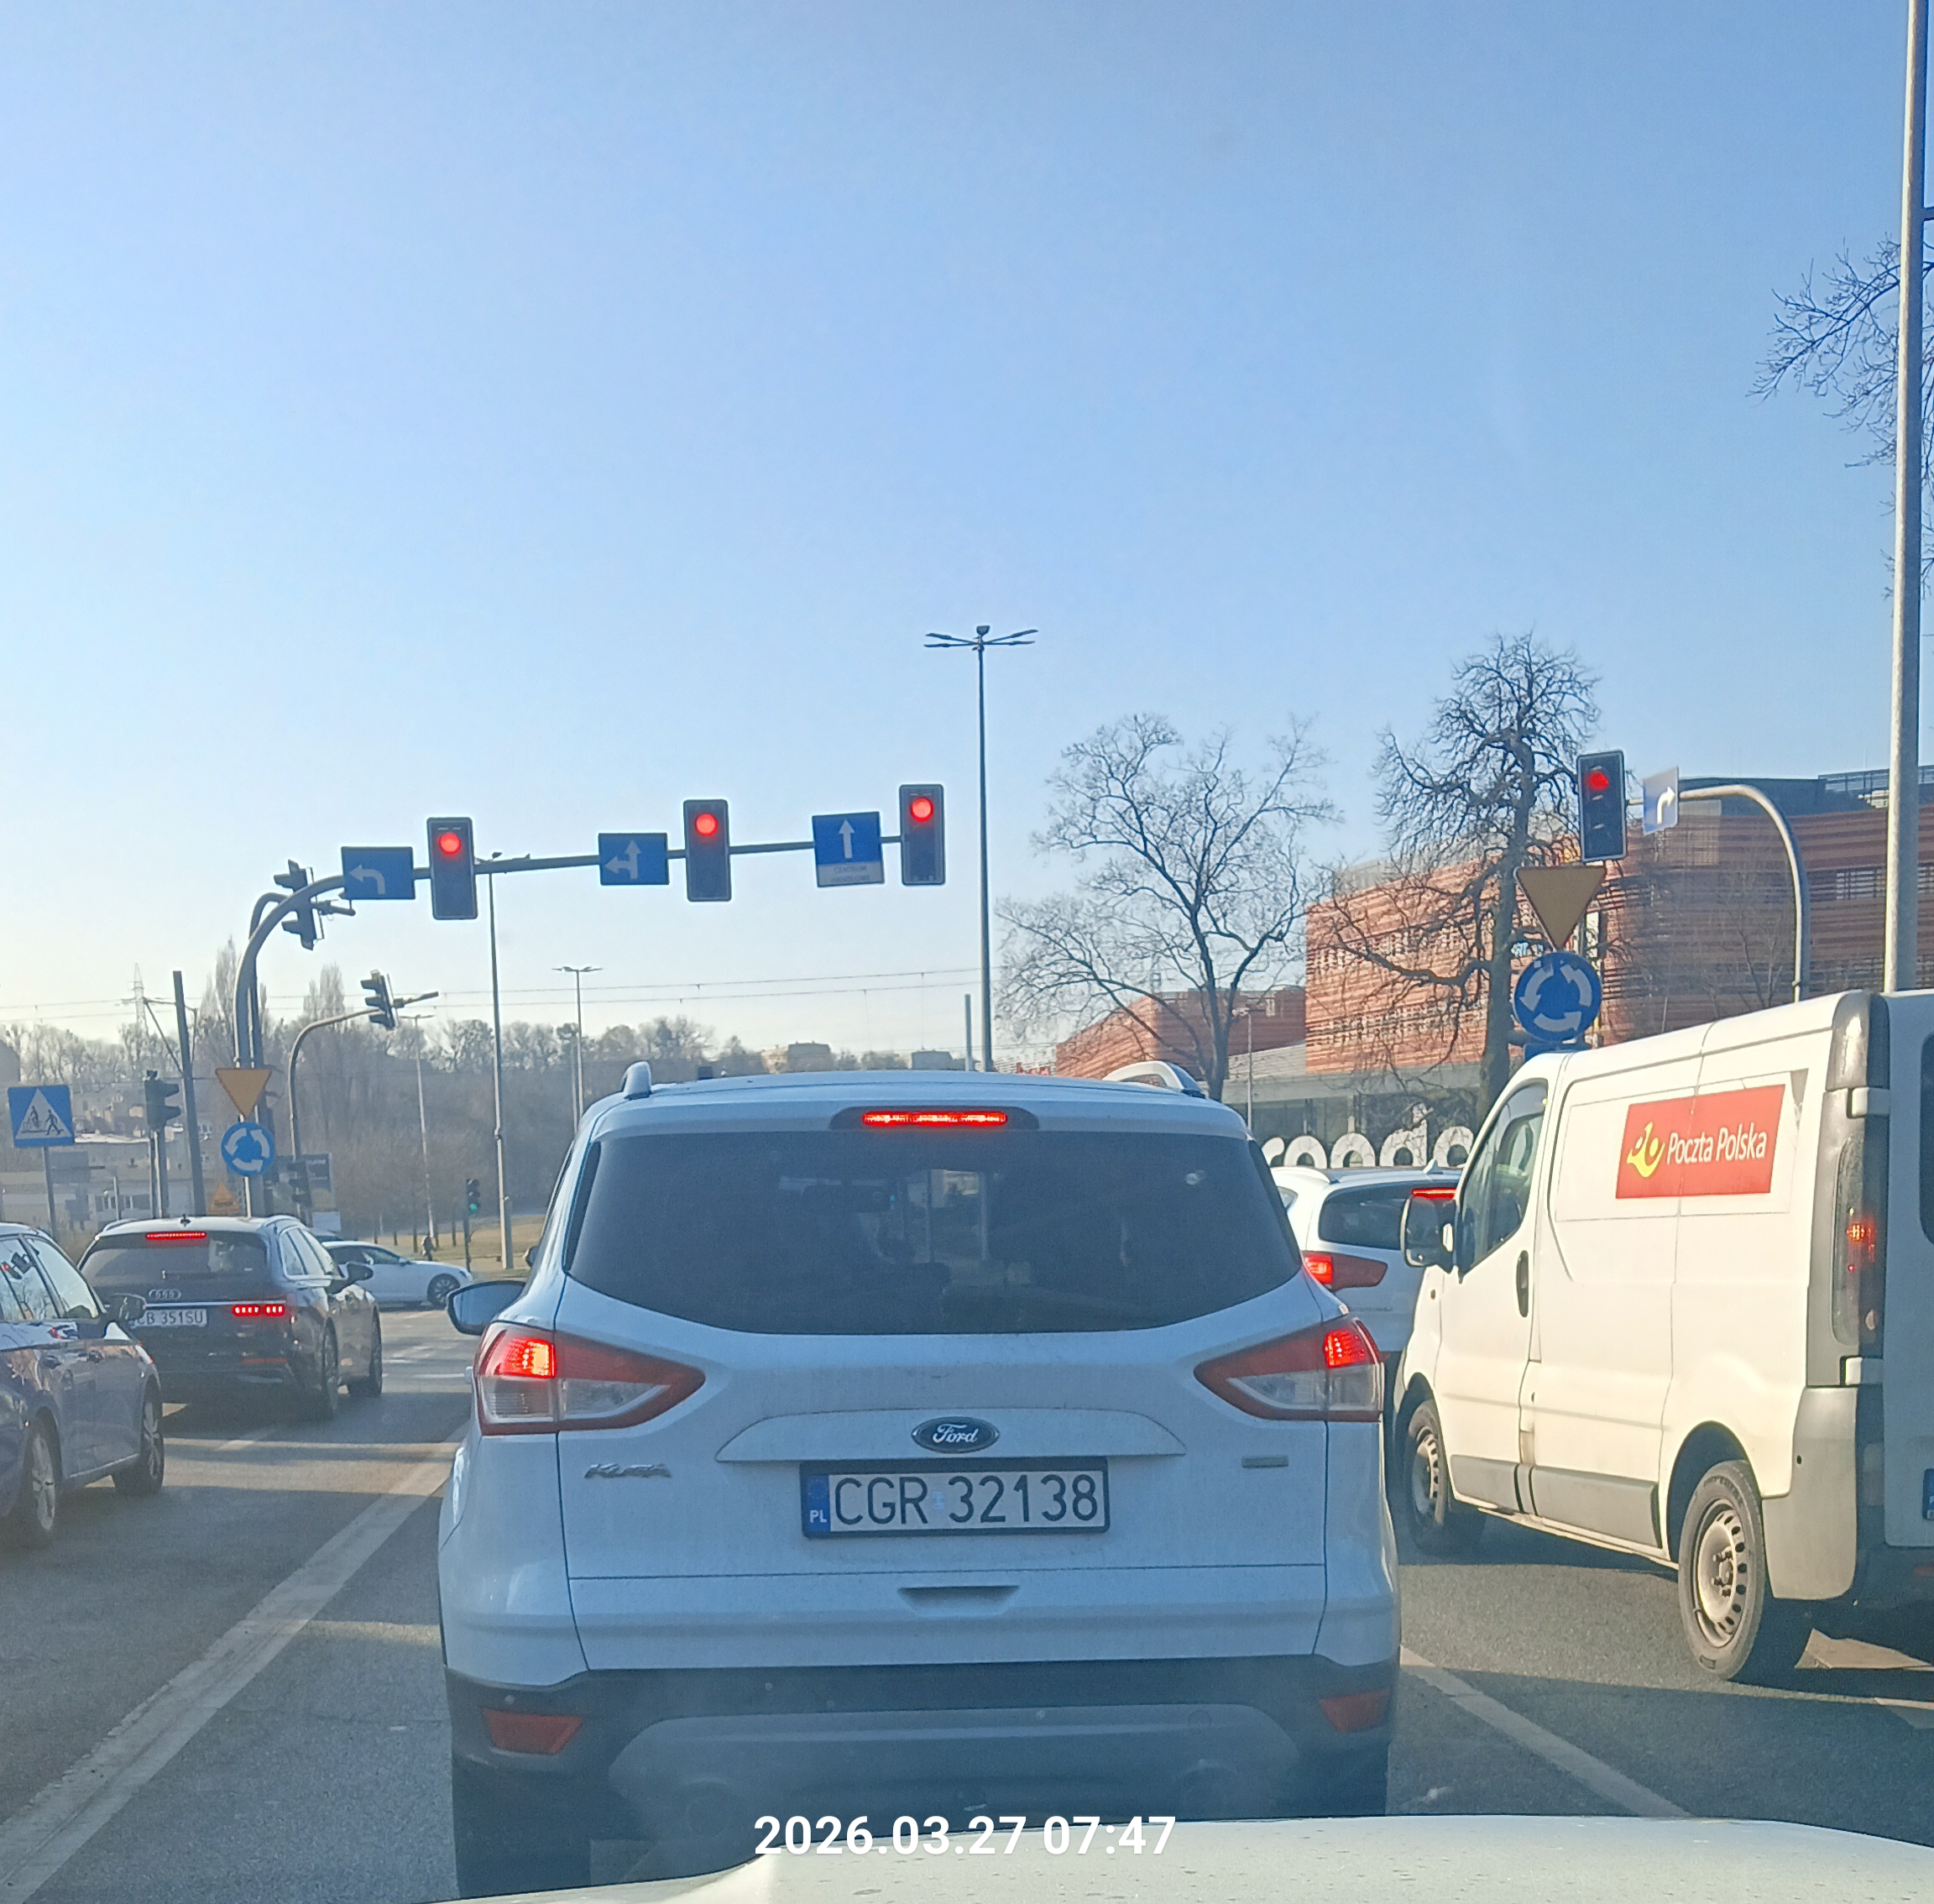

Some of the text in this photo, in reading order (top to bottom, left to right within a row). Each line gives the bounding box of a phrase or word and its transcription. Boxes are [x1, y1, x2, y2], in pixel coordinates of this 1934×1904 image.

[1667, 1122, 1768, 1165] Poczta Polska
[933, 1423, 979, 1444] Ford
[834, 1473, 1098, 1525] CGR 32138
[809, 1509, 828, 1524] PL
